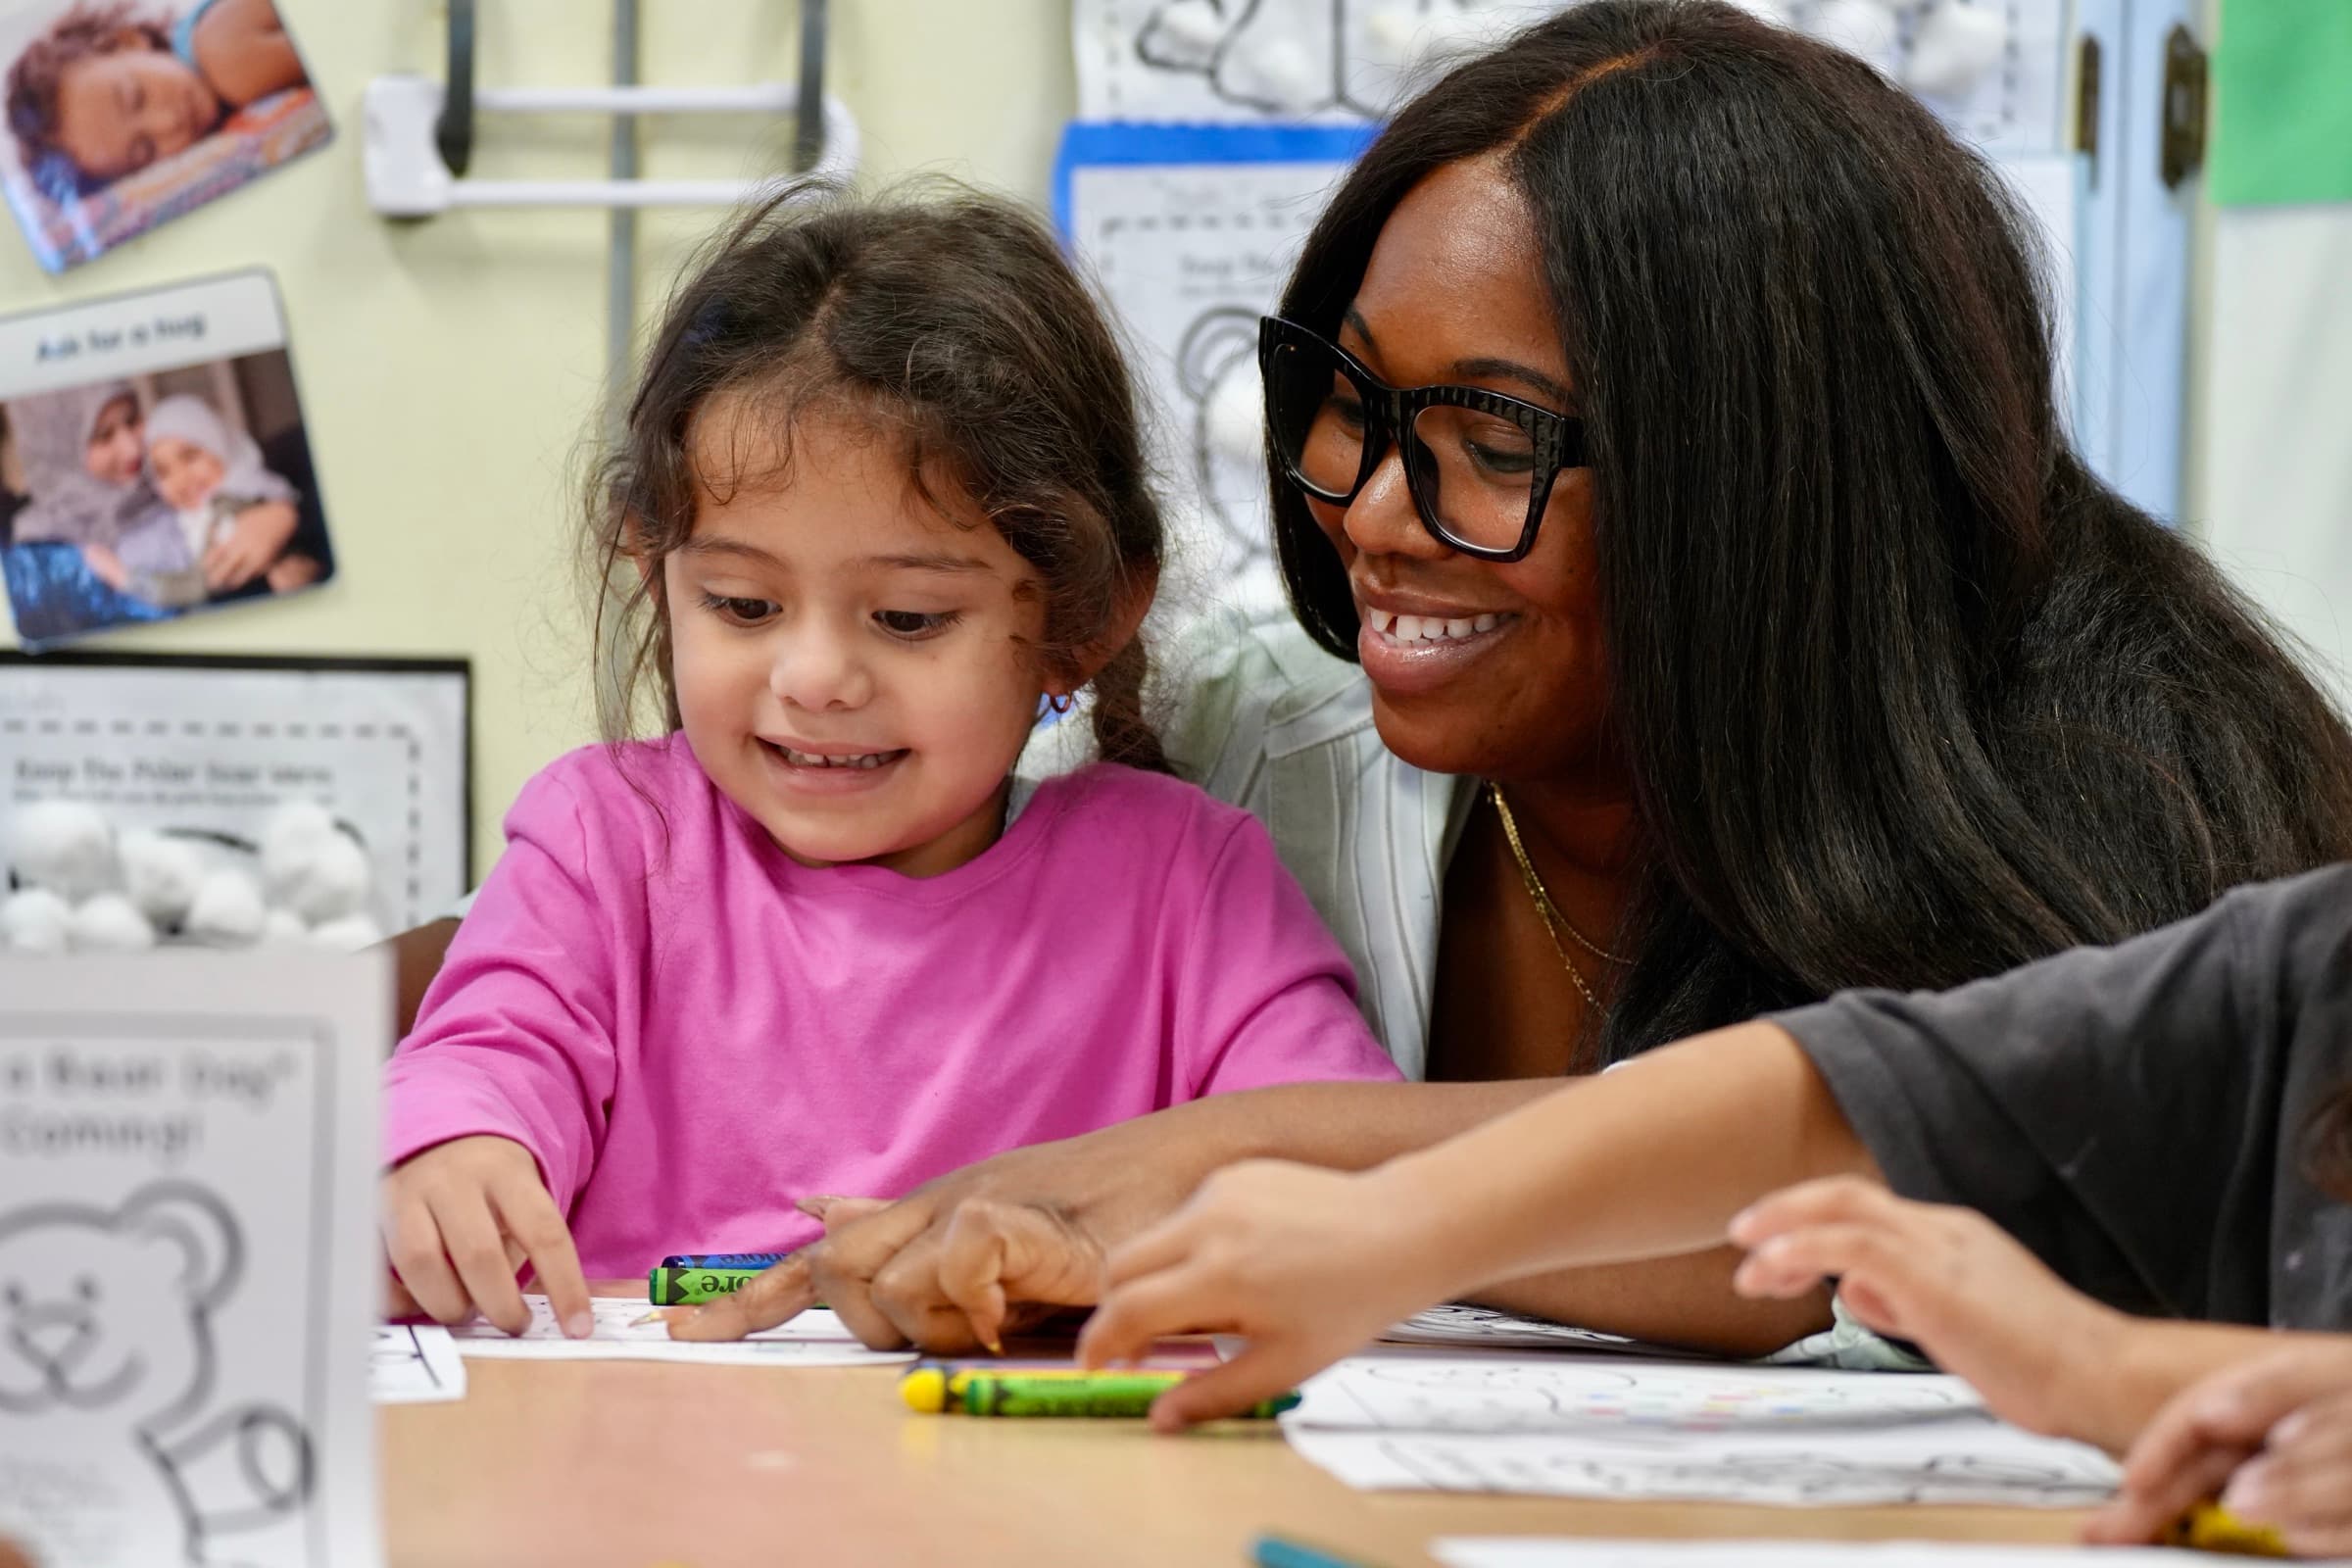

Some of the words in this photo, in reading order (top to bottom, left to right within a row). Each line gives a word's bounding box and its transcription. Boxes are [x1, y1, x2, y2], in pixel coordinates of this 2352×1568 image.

[36, 336, 80, 364] Ask
[88, 327, 122, 351] for
[130, 324, 150, 345] a
[154, 314, 206, 339] hug
